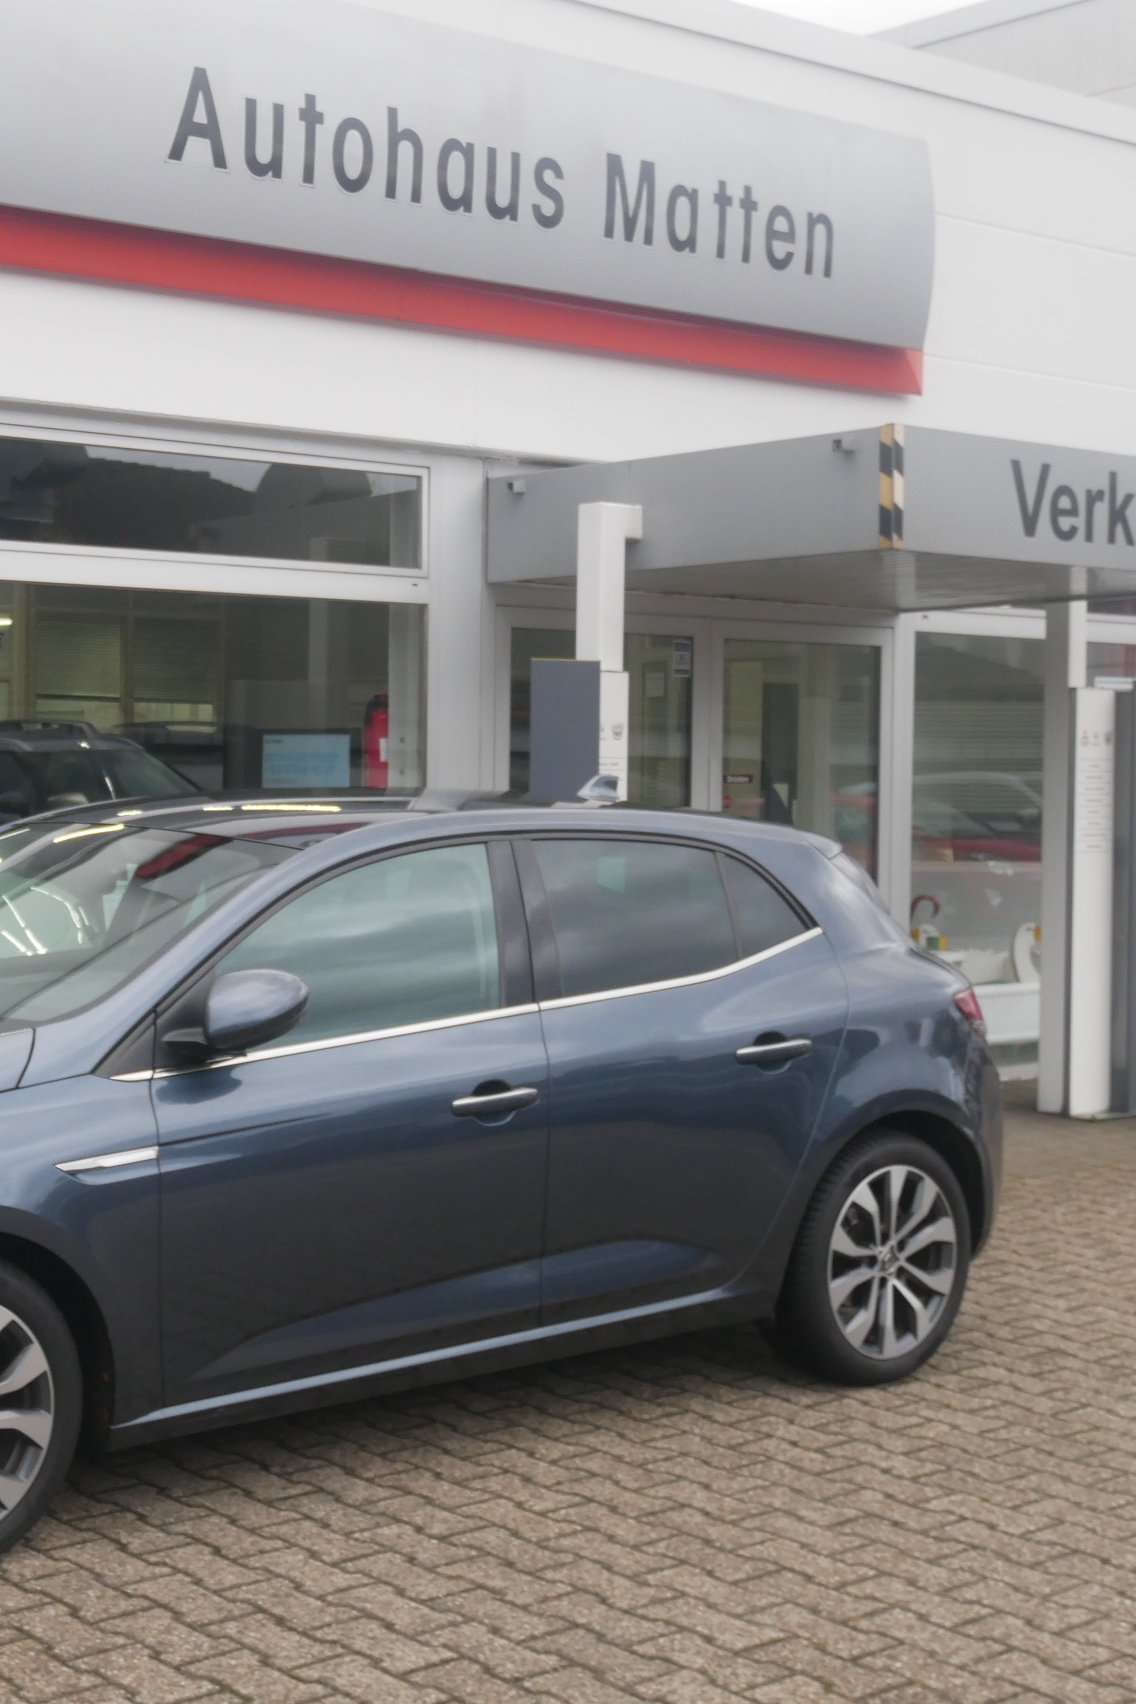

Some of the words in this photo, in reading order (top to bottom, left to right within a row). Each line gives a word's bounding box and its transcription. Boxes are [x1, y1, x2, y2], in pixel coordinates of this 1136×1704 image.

[167, 66, 565, 230] Autohaus
[603, 152, 835, 279] Matten
[1009, 459, 1136, 547] Verk
